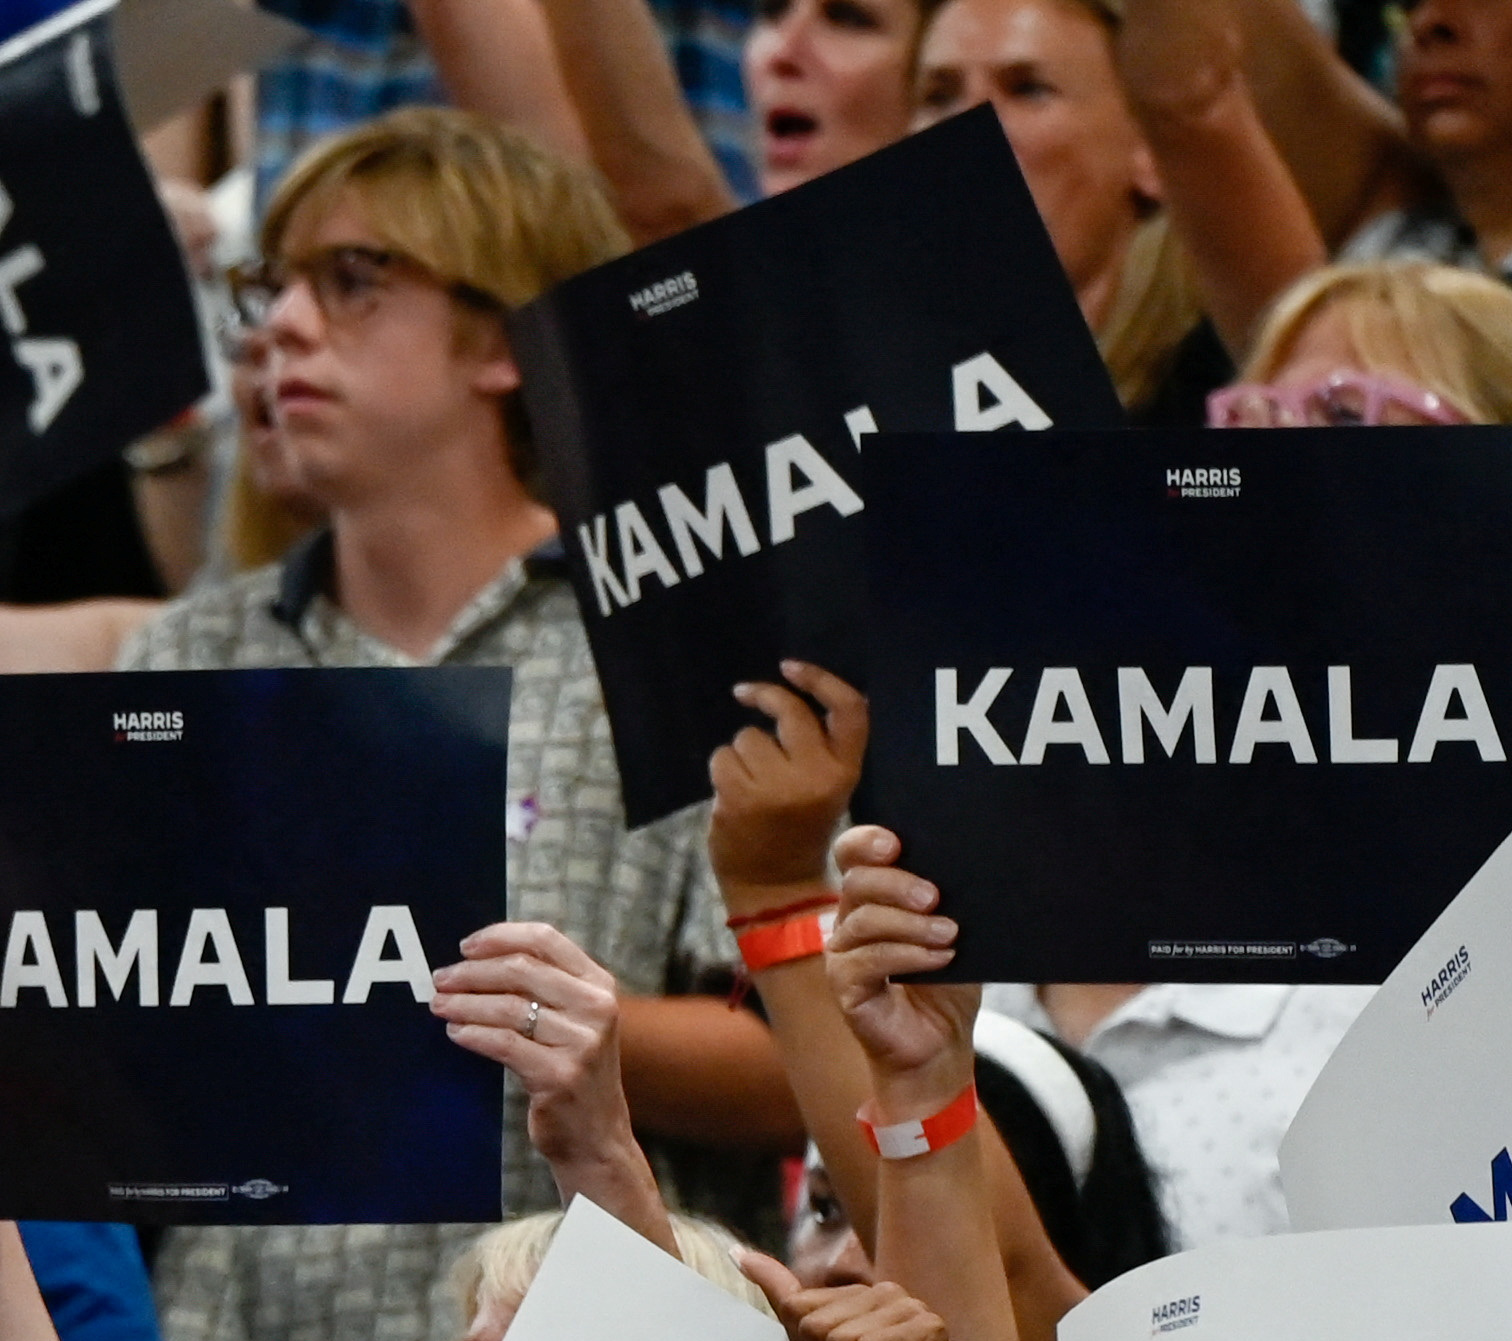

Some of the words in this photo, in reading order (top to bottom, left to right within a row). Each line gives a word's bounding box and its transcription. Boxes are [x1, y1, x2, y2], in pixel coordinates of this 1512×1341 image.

[627, 271, 697, 312] HARRIS
[579, 351, 1053, 617] KAMAA
[1166, 468, 1242, 487] HARRIS
[1181, 487, 1241, 498] PRESIDENT
[113, 712, 184, 730] HARRIS
[935, 663, 1507, 766] KAMALA
[127, 731, 183, 743] PRESIDENT
[1420, 944, 1471, 1008] HARRIS
[1435, 962, 1472, 1009] PRESIDENT
[1151, 1294, 1201, 1326] HARRIS
